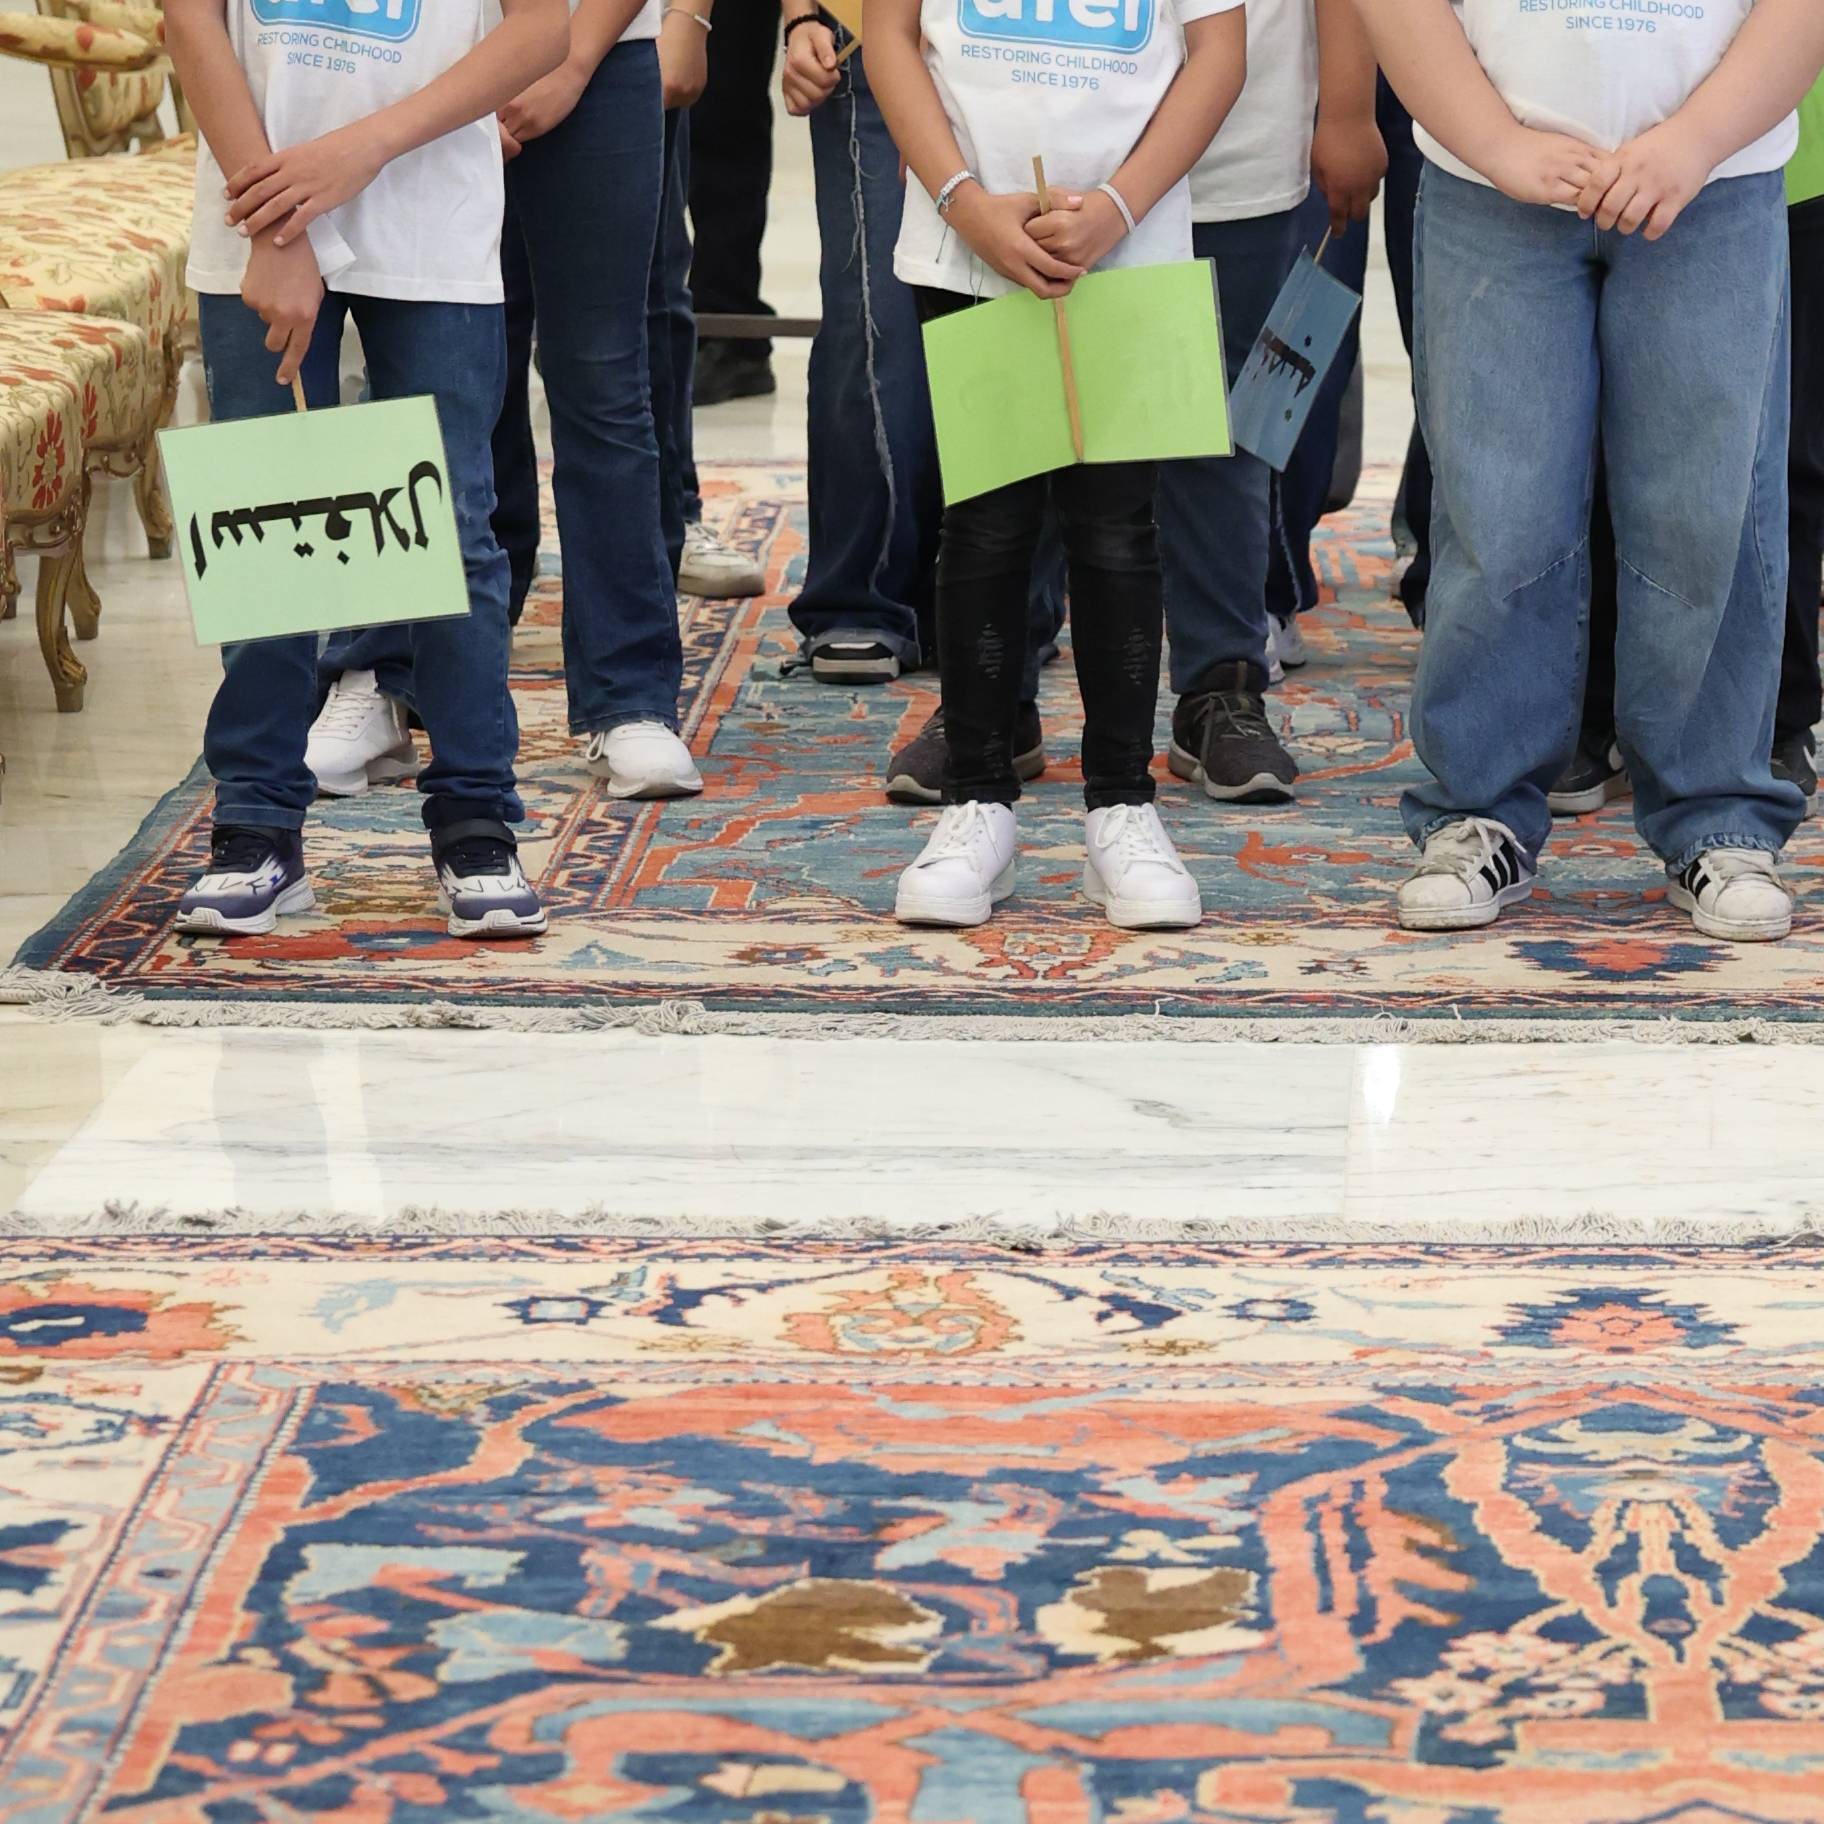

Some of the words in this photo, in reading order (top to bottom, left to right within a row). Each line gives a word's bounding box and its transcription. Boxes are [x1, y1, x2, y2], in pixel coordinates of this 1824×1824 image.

[1565, 16, 1613, 30] SINCE
[1617, 18, 1656, 33] 1976
[257, 31, 320, 48] RESTORING
[322, 36, 402, 64] CHILDHOOD
[960, 44, 1052, 65] RESTORING
[1055, 54, 1138, 75] CHILDHOOD
[287, 51, 323, 68] SINCE
[326, 57, 356, 74] 1976
[1011, 70, 1058, 86] SINCE
[1062, 74, 1100, 91] 1976
[190, 460, 442, 581] استغلال
